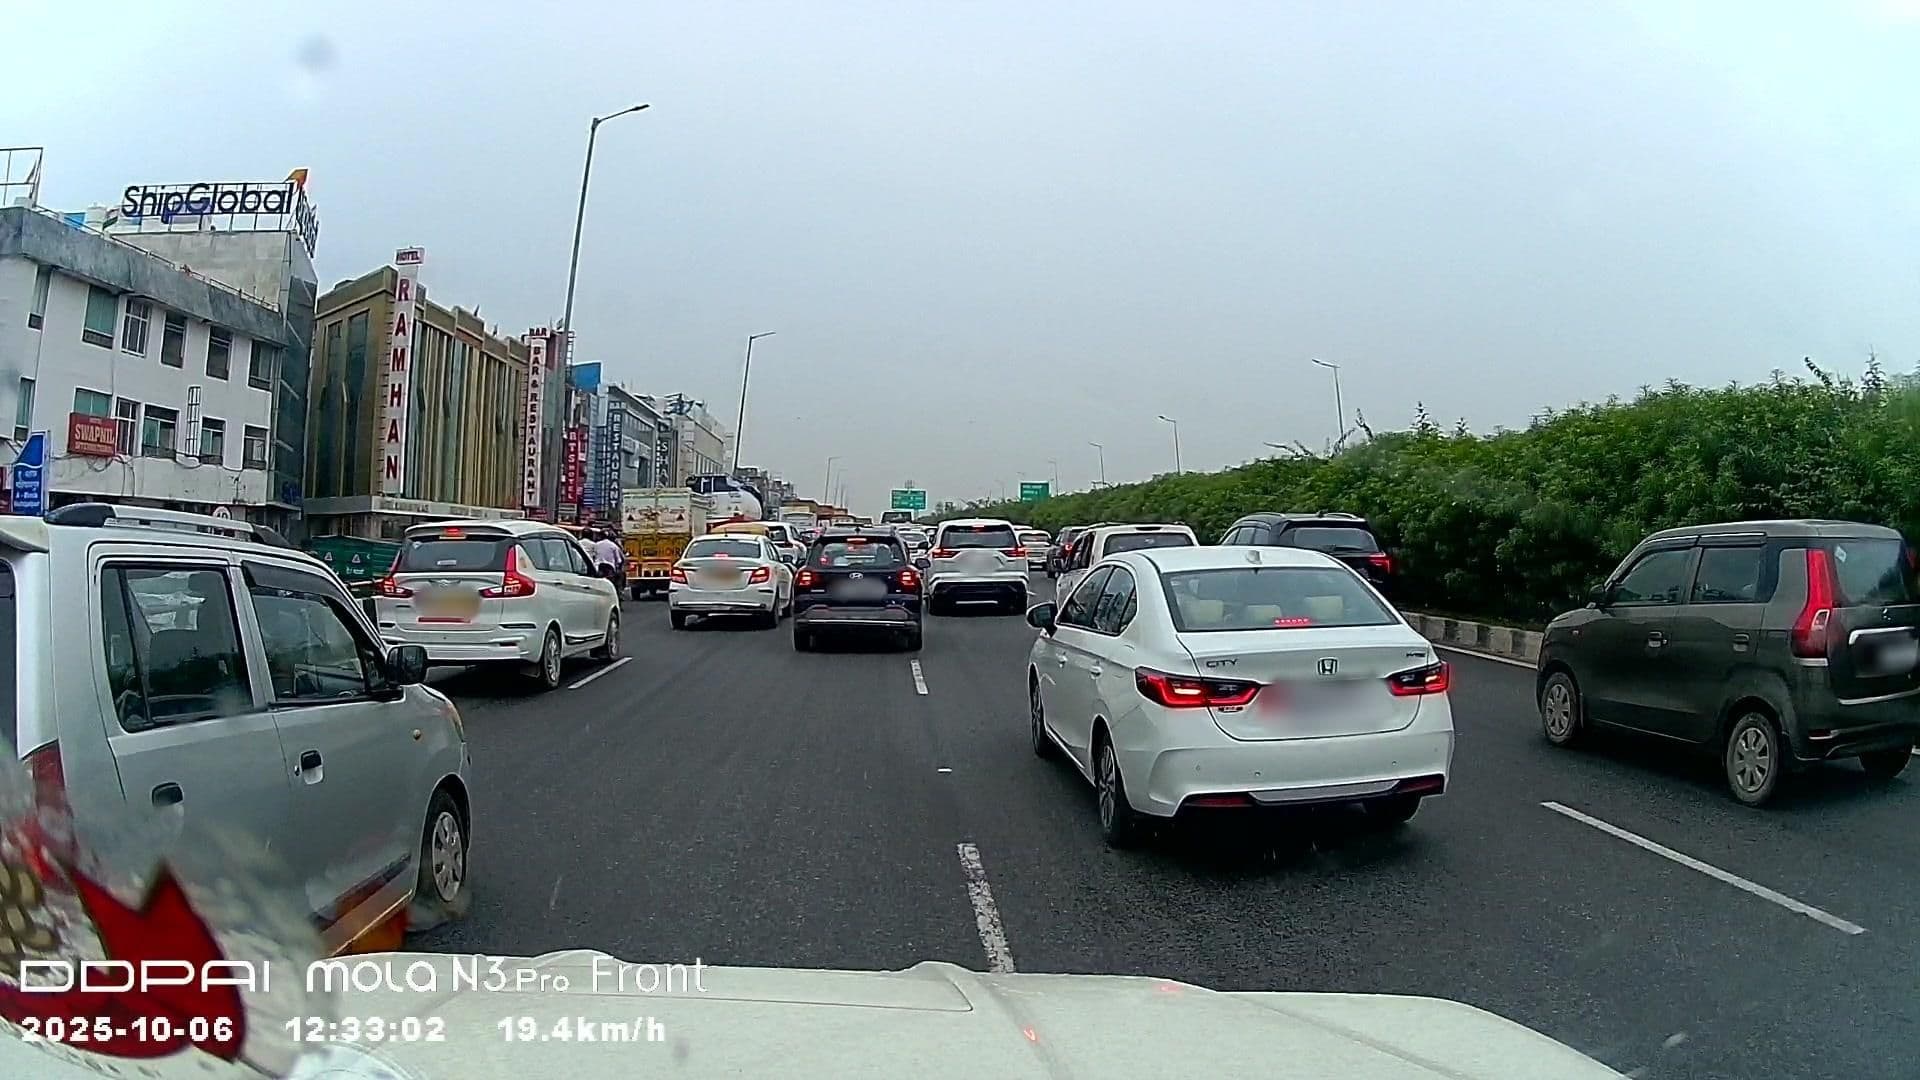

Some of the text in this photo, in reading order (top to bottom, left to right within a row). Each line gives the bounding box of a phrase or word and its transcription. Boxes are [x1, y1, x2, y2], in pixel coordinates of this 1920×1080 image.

[123, 182, 294, 224] ShipGlobal
[385, 278, 410, 480] RAMHAN
[74, 423, 115, 444] SWAPNIL
[526, 393, 540, 503] RESTAURANT
[610, 413, 622, 508] RESTAURANT
[1206, 658, 1239, 668] CITY
